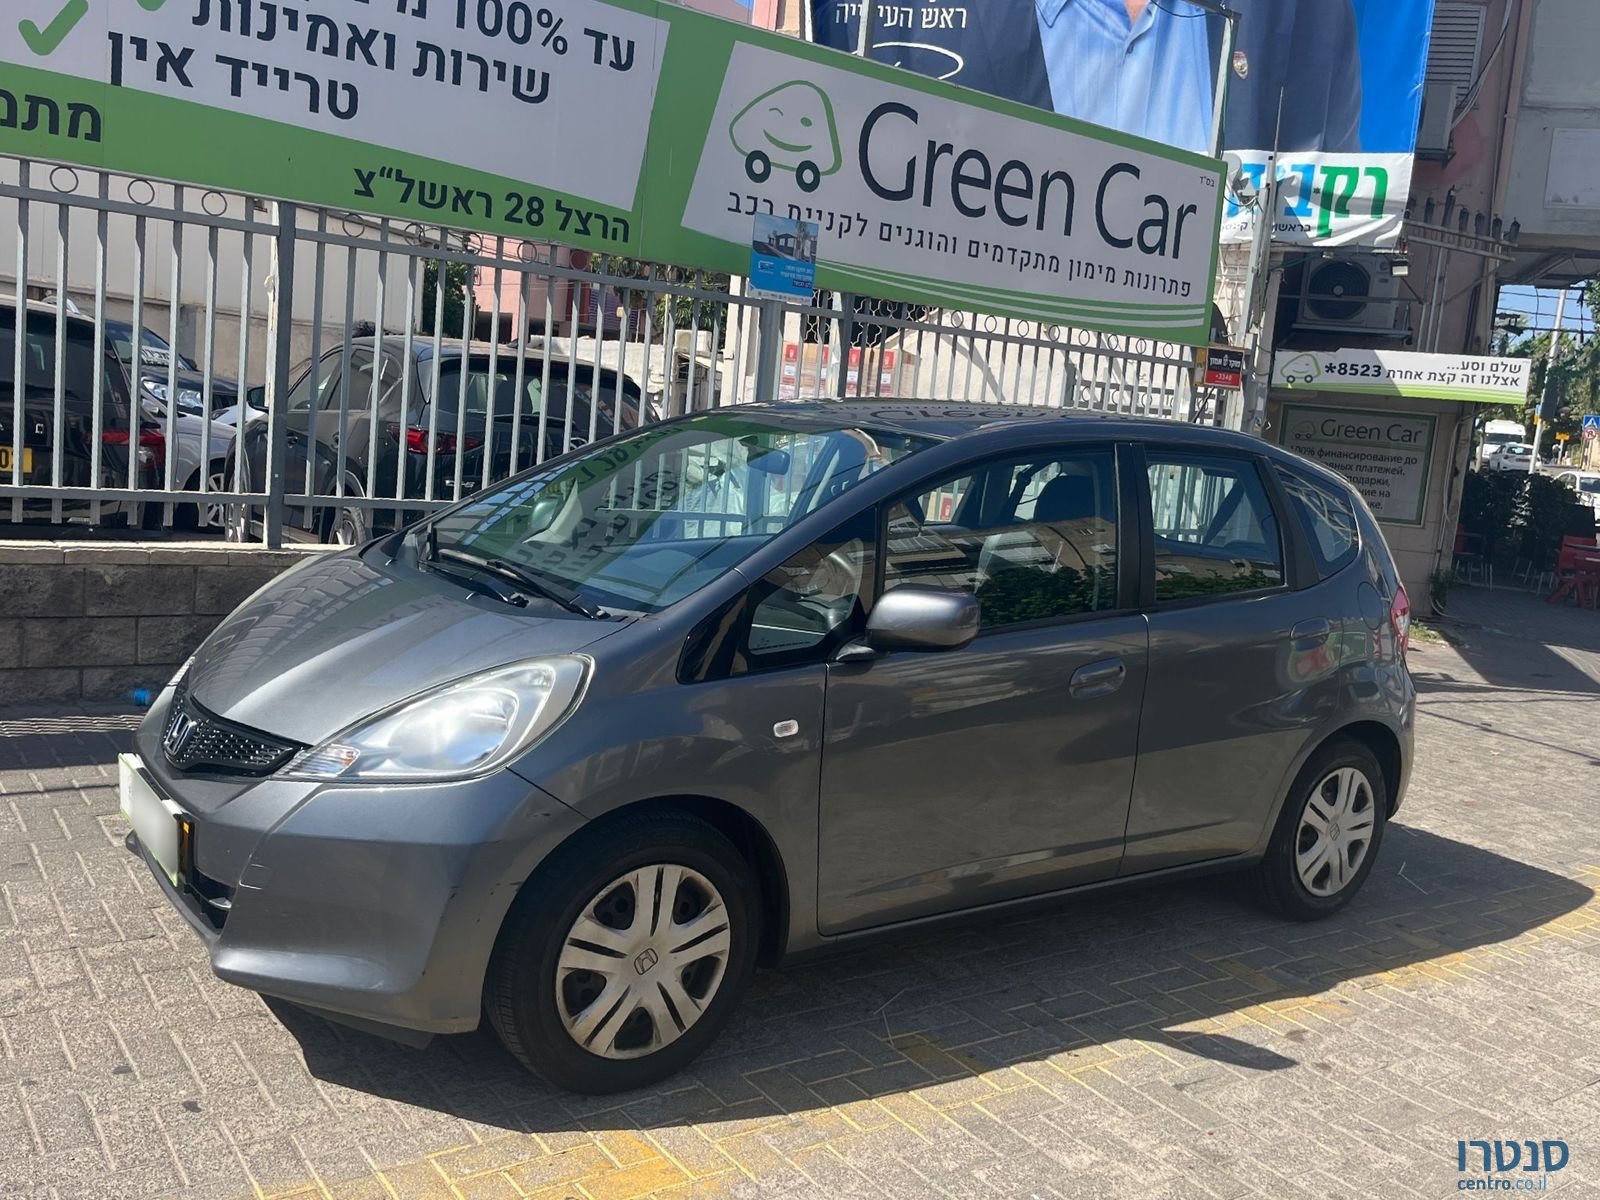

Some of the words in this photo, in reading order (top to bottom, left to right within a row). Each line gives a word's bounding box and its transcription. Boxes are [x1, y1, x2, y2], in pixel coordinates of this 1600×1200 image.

[455, 0, 568, 55] 100%
[835, 3, 914, 28] העיייה
[921, 7, 967, 28] ראש
[192, 0, 396, 71] ואמינות
[583, 27, 636, 72] עד
[108, 31, 195, 88] אין
[215, 54, 359, 120] טרייד
[412, 40, 550, 104] שירות
[858, 101, 1075, 237] Green
[1094, 162, 1197, 260] Car
[504, 192, 545, 227] 28
[727, 191, 774, 216] רכב
[1316, 165, 1388, 237] רק
[555, 199, 630, 243] הרצל
[787, 203, 868, 239] לקניית
[879, 222, 957, 254] והוגנים
[967, 239, 1060, 273] מתקדמים
[1069, 258, 1116, 283] מימון
[1123, 269, 1192, 298] פתרונות
[1386, 368, 1424, 381] אחרת
[1427, 372, 1456, 385] קצת
[1446, 360, 1485, 371] וסע...
[1460, 373, 1476, 384] זה
[1489, 361, 1522, 374] שלם
[1480, 373, 1520, 387] אצלנו
[1320, 418, 1381, 441] Green
[1386, 423, 1423, 443] Car
[1316, 447, 1403, 464] финансирование
[1403, 456, 1418, 465] до
[1354, 463, 1405, 476] платежей.
